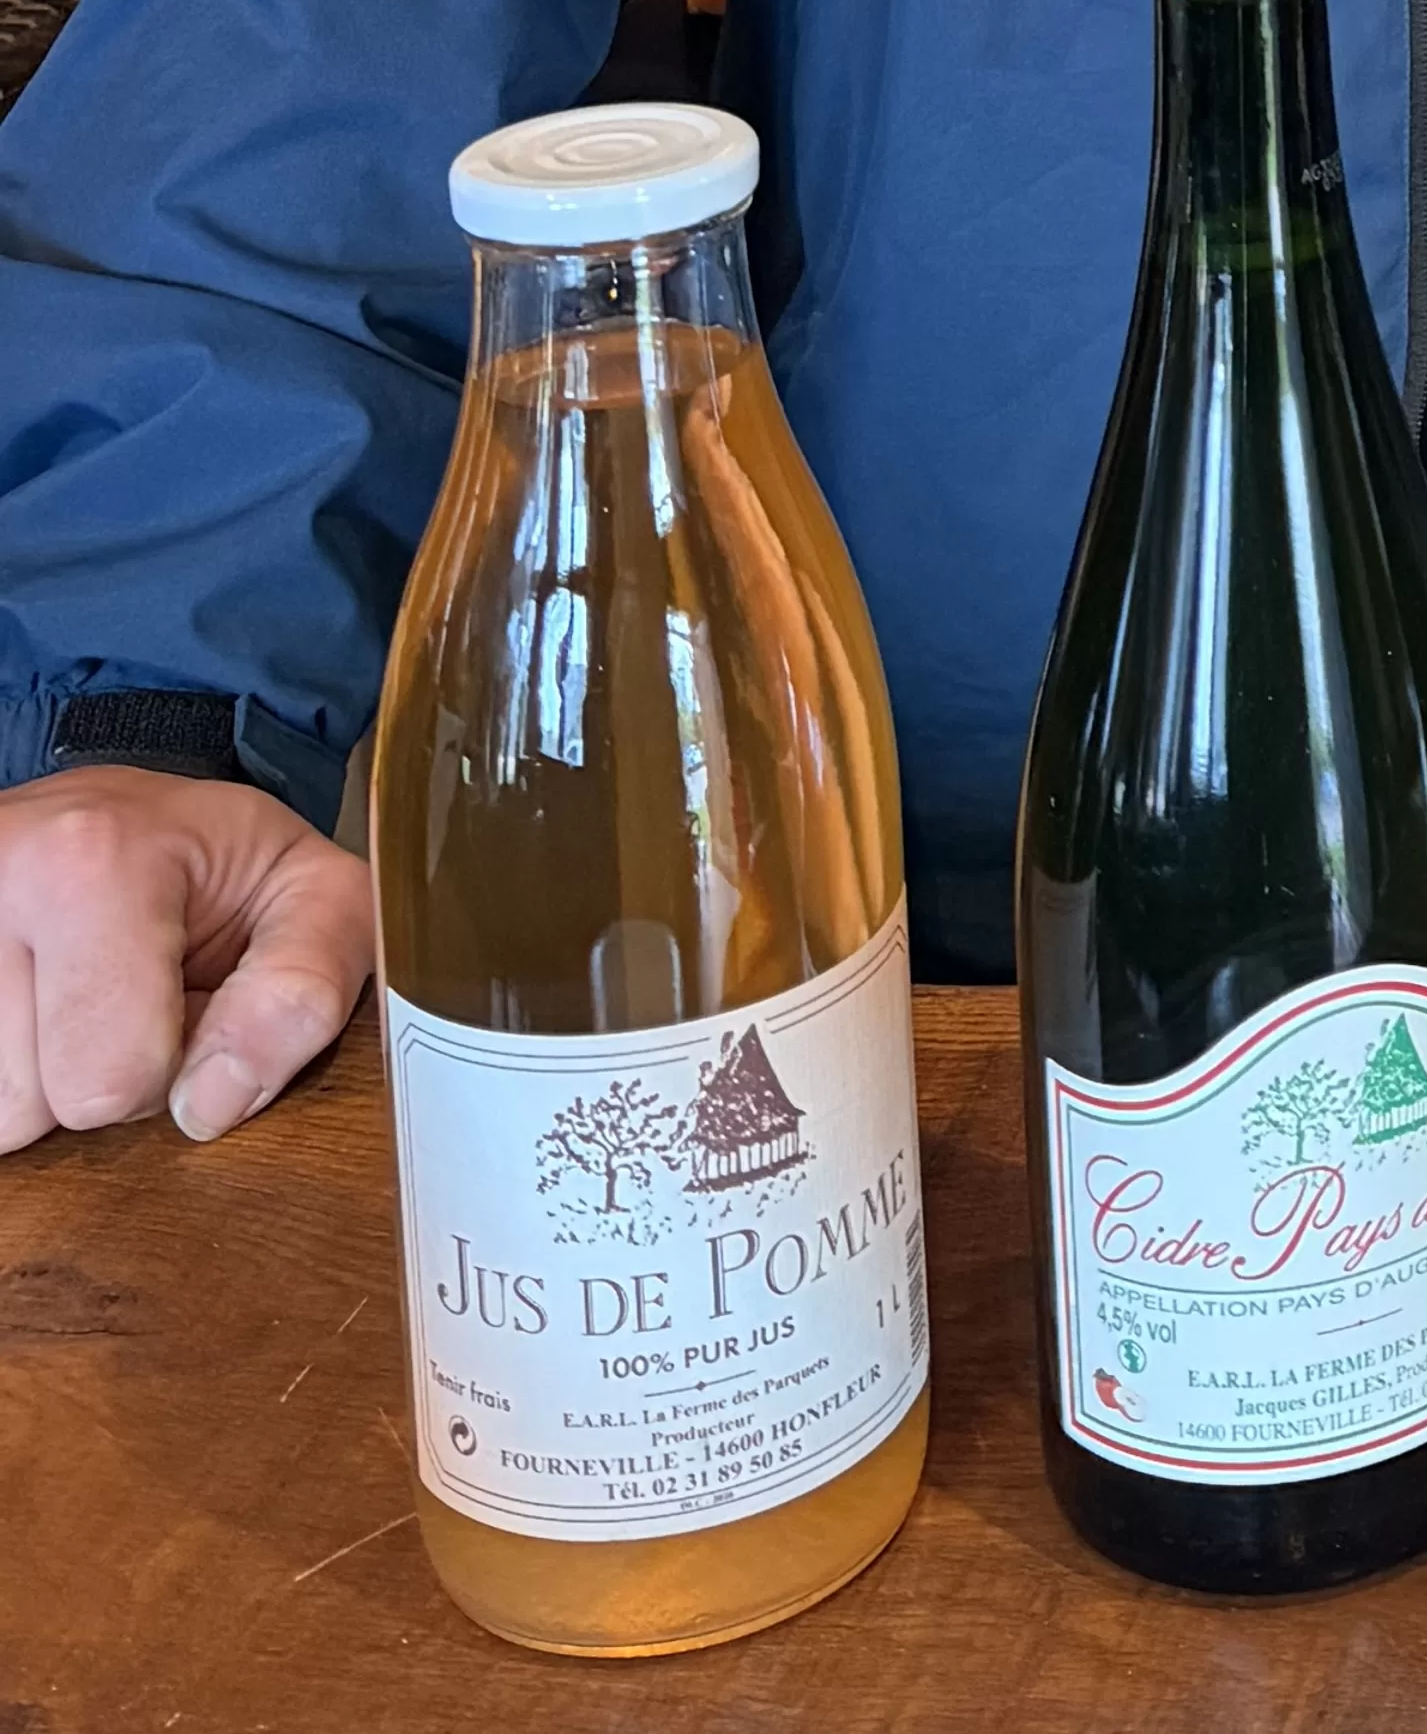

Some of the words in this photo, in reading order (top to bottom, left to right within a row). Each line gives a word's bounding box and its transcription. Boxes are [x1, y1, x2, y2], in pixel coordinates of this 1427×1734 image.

[578, 1271, 673, 1337] DE
[704, 1147, 907, 1320] POMME
[1084, 1153, 1231, 1269] Cidre
[1230, 1160, 1404, 1282] Pays
[1096, 1301, 1143, 1338] 4,5%
[1146, 1318, 1177, 1345] vol
[1097, 1279, 1268, 1318] APPELLATION
[1278, 1286, 1346, 1314] PAYS
[599, 1350, 676, 1380] 100%
[683, 1336, 741, 1369] PUR
[747, 1315, 796, 1353] JUS
[1270, 1368, 1299, 1388] LA
[1304, 1348, 1376, 1383] FERME
[1381, 1333, 1417, 1363] DES
[428, 1358, 467, 1397] Tenir
[469, 1379, 512, 1413] frais
[562, 1411, 638, 1429] E.A.R.L.
[640, 1408, 667, 1425] La
[671, 1395, 728, 1421] Ferme
[730, 1386, 760, 1407] des
[763, 1355, 831, 1397] Parquets
[1234, 1396, 1308, 1420] Jacques
[1311, 1371, 1393, 1408] GILLES,
[499, 1448, 681, 1477] FOURNEVILLE
[703, 1428, 765, 1463] 14600
[769, 1362, 883, 1443] HONFLEUR
[650, 1412, 756, 1449] Producteur
[1177, 1420, 1226, 1442] 14600
[1230, 1402, 1374, 1442] FOURNEVILLE
[602, 1481, 646, 1501] Tél.
[651, 1476, 679, 1497] 02
[684, 1471, 710, 1491] 31
[717, 1461, 743, 1484] 89
[749, 1450, 774, 1474] 50
[778, 1438, 803, 1463] 85
